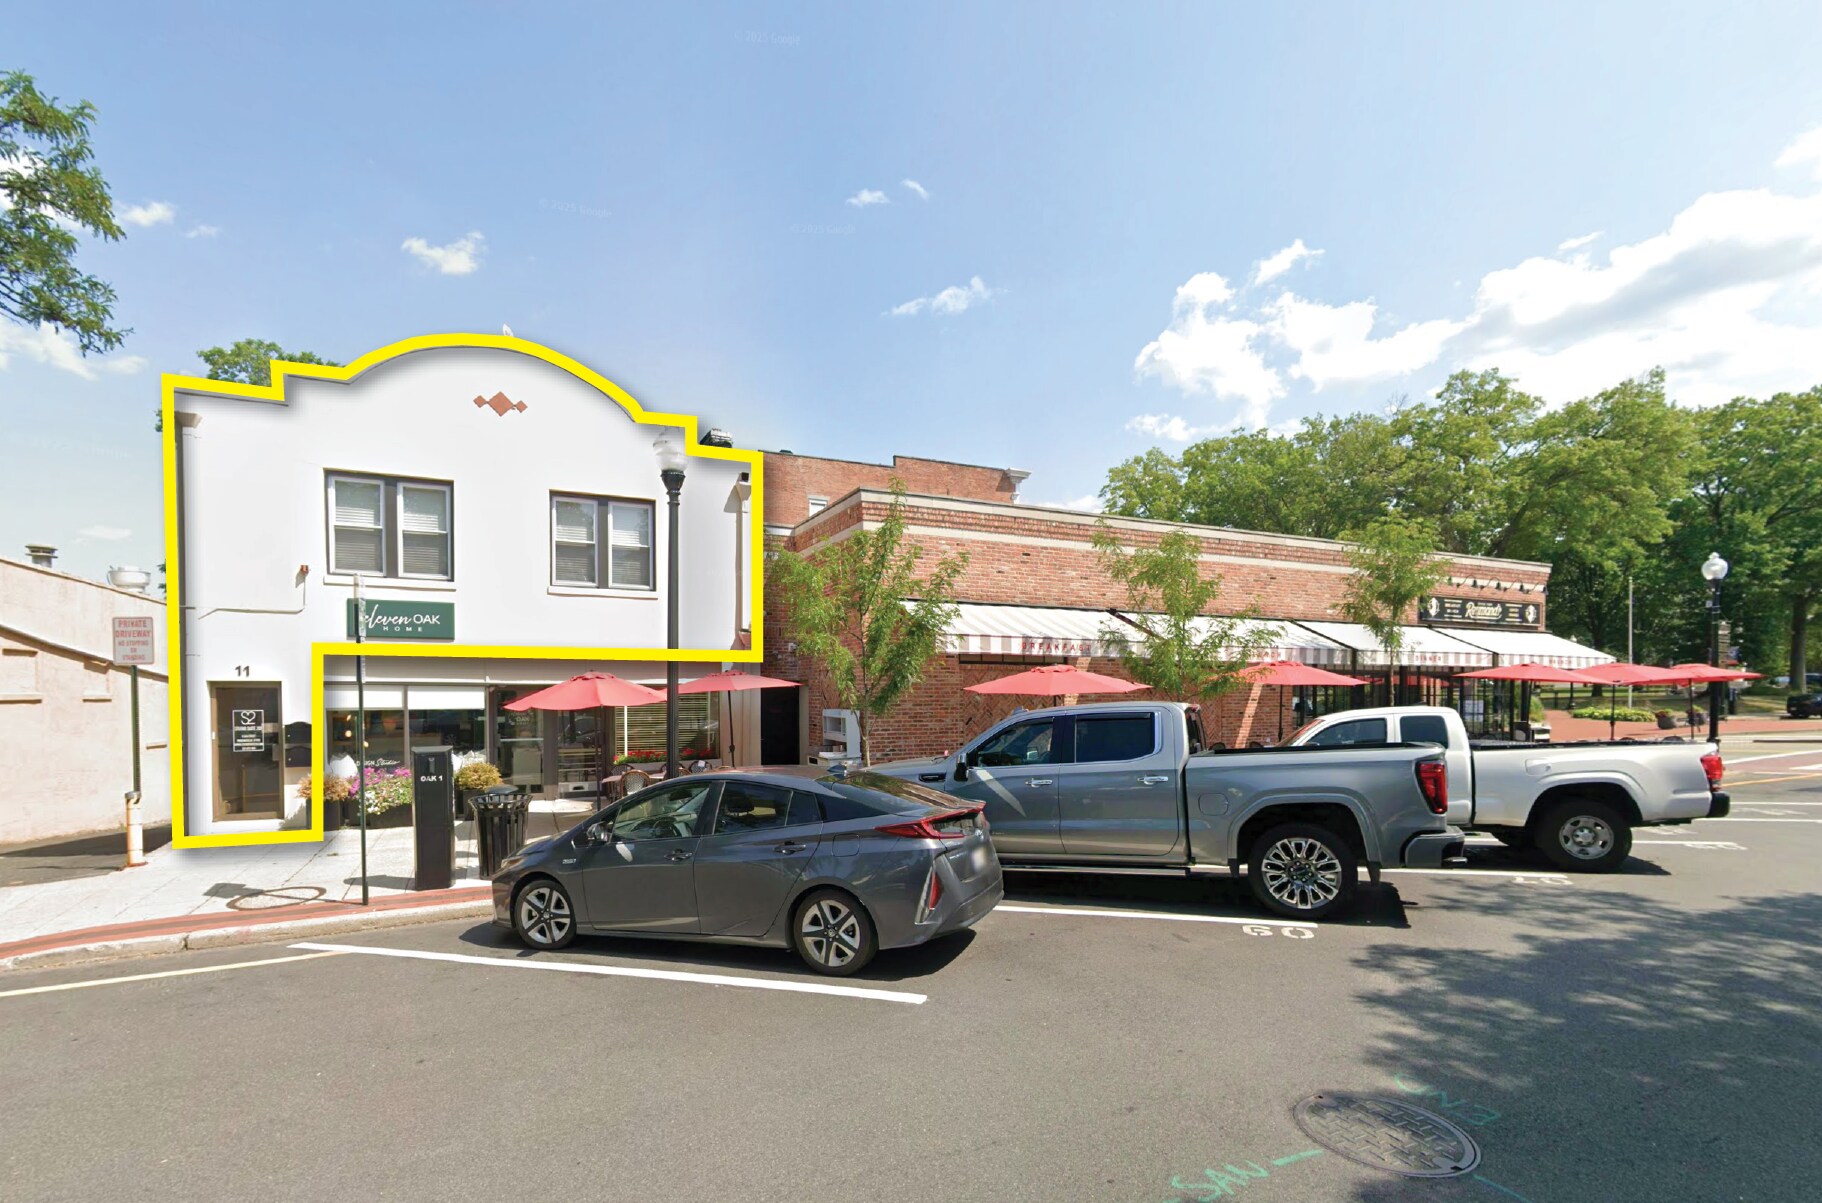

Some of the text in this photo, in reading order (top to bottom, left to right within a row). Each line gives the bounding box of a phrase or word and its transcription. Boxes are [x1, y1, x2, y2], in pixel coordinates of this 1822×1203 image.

[118, 620, 147, 628] PRIVATE
[412, 613, 440, 625] OAK
[115, 630, 151, 638] DRIVEWAY
[1021, 642, 1092, 652] BREAKFAST
[235, 665, 250, 677] 11
